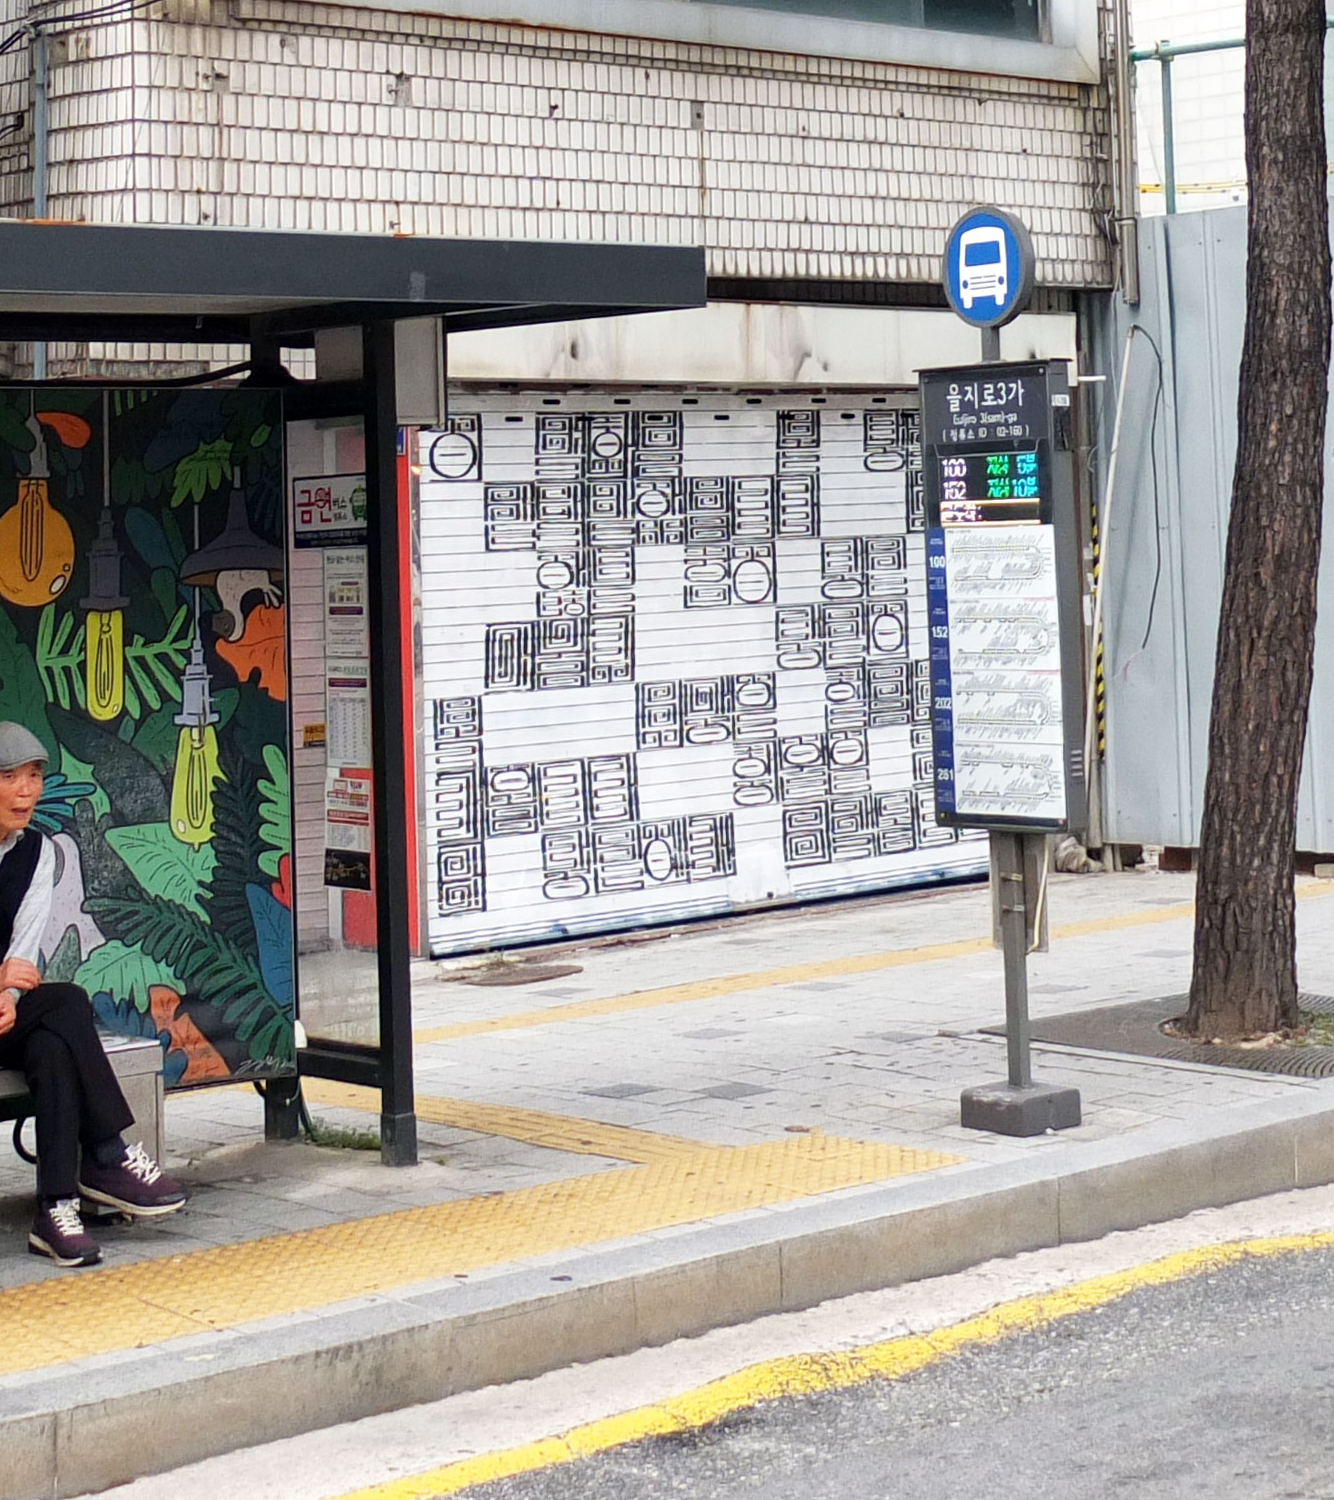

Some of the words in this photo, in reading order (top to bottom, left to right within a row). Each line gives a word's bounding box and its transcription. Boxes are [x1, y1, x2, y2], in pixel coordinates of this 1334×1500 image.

[946, 379, 1025, 412] 을지로3가
[942, 458, 966, 477] 100
[942, 481, 967, 500] 152
[929, 556, 946, 568] 100
[931, 626, 948, 638] 152
[934, 697, 952, 709] 202
